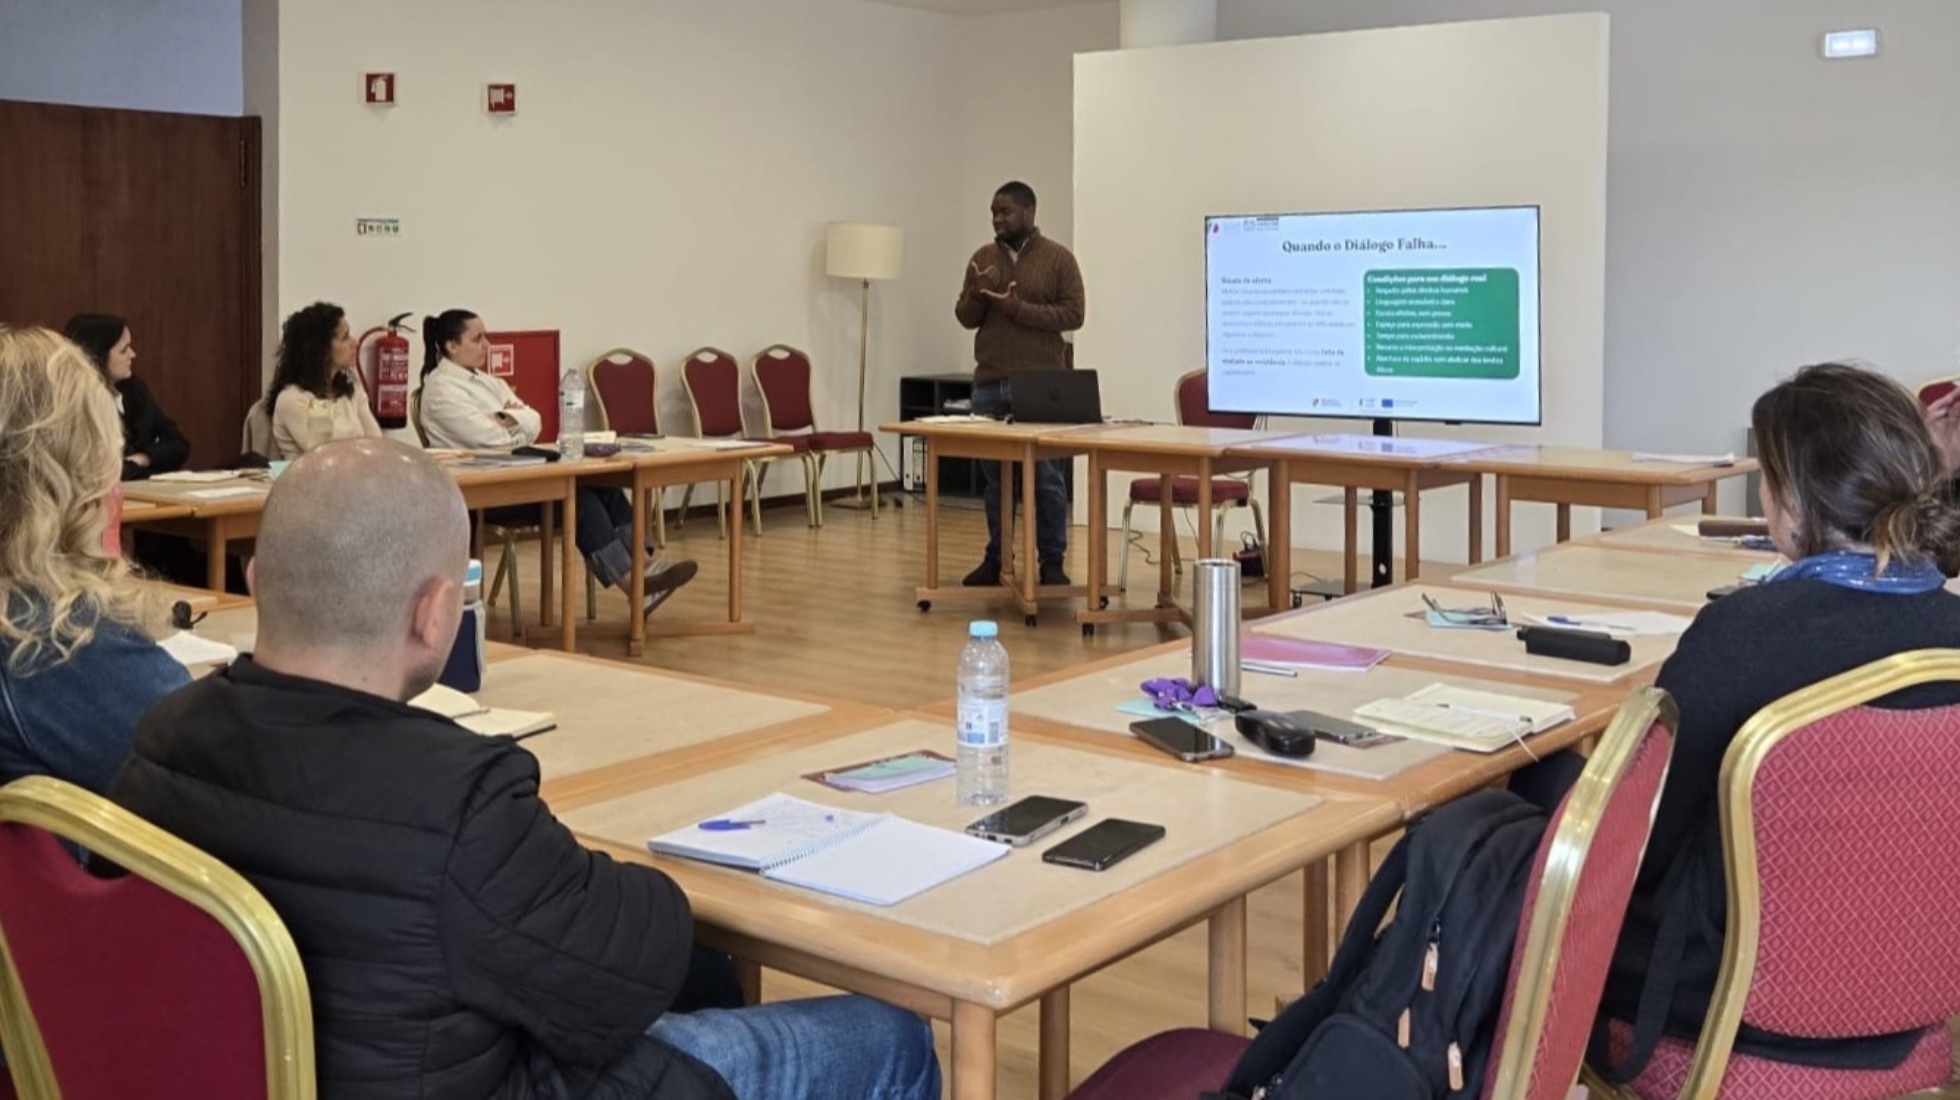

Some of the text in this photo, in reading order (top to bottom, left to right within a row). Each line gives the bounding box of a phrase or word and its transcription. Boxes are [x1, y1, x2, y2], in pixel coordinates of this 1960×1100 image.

[1282, 239, 1331, 253] Quando
[1334, 243, 1341, 251] o
[1344, 238, 1393, 253] Diálogo
